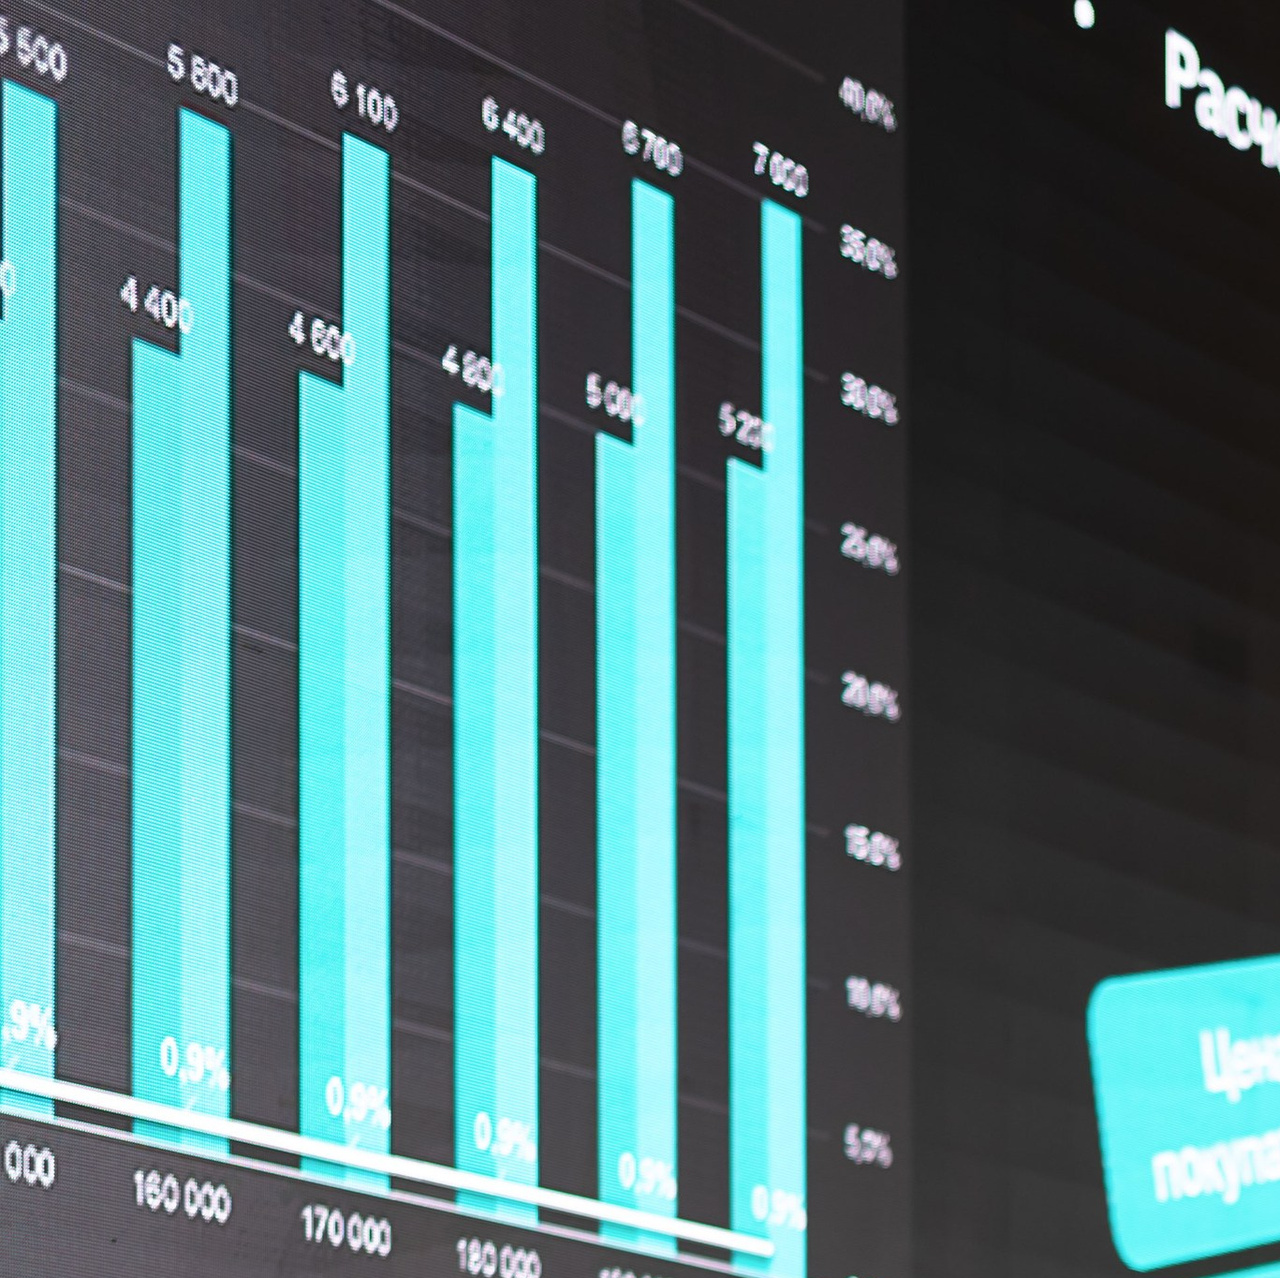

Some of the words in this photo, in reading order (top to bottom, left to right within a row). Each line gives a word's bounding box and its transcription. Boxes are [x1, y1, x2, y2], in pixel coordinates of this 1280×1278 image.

[356, 83, 399, 132] 100
[753, 141, 769, 175] 7
[121, 275, 138, 313] 4
[288, 310, 306, 345] 4
[160, 1036, 230, 1091] 0,9%
[184, 1178, 232, 1226] 000
[302, 1204, 344, 1248] 170
[347, 1210, 392, 1257] 000
